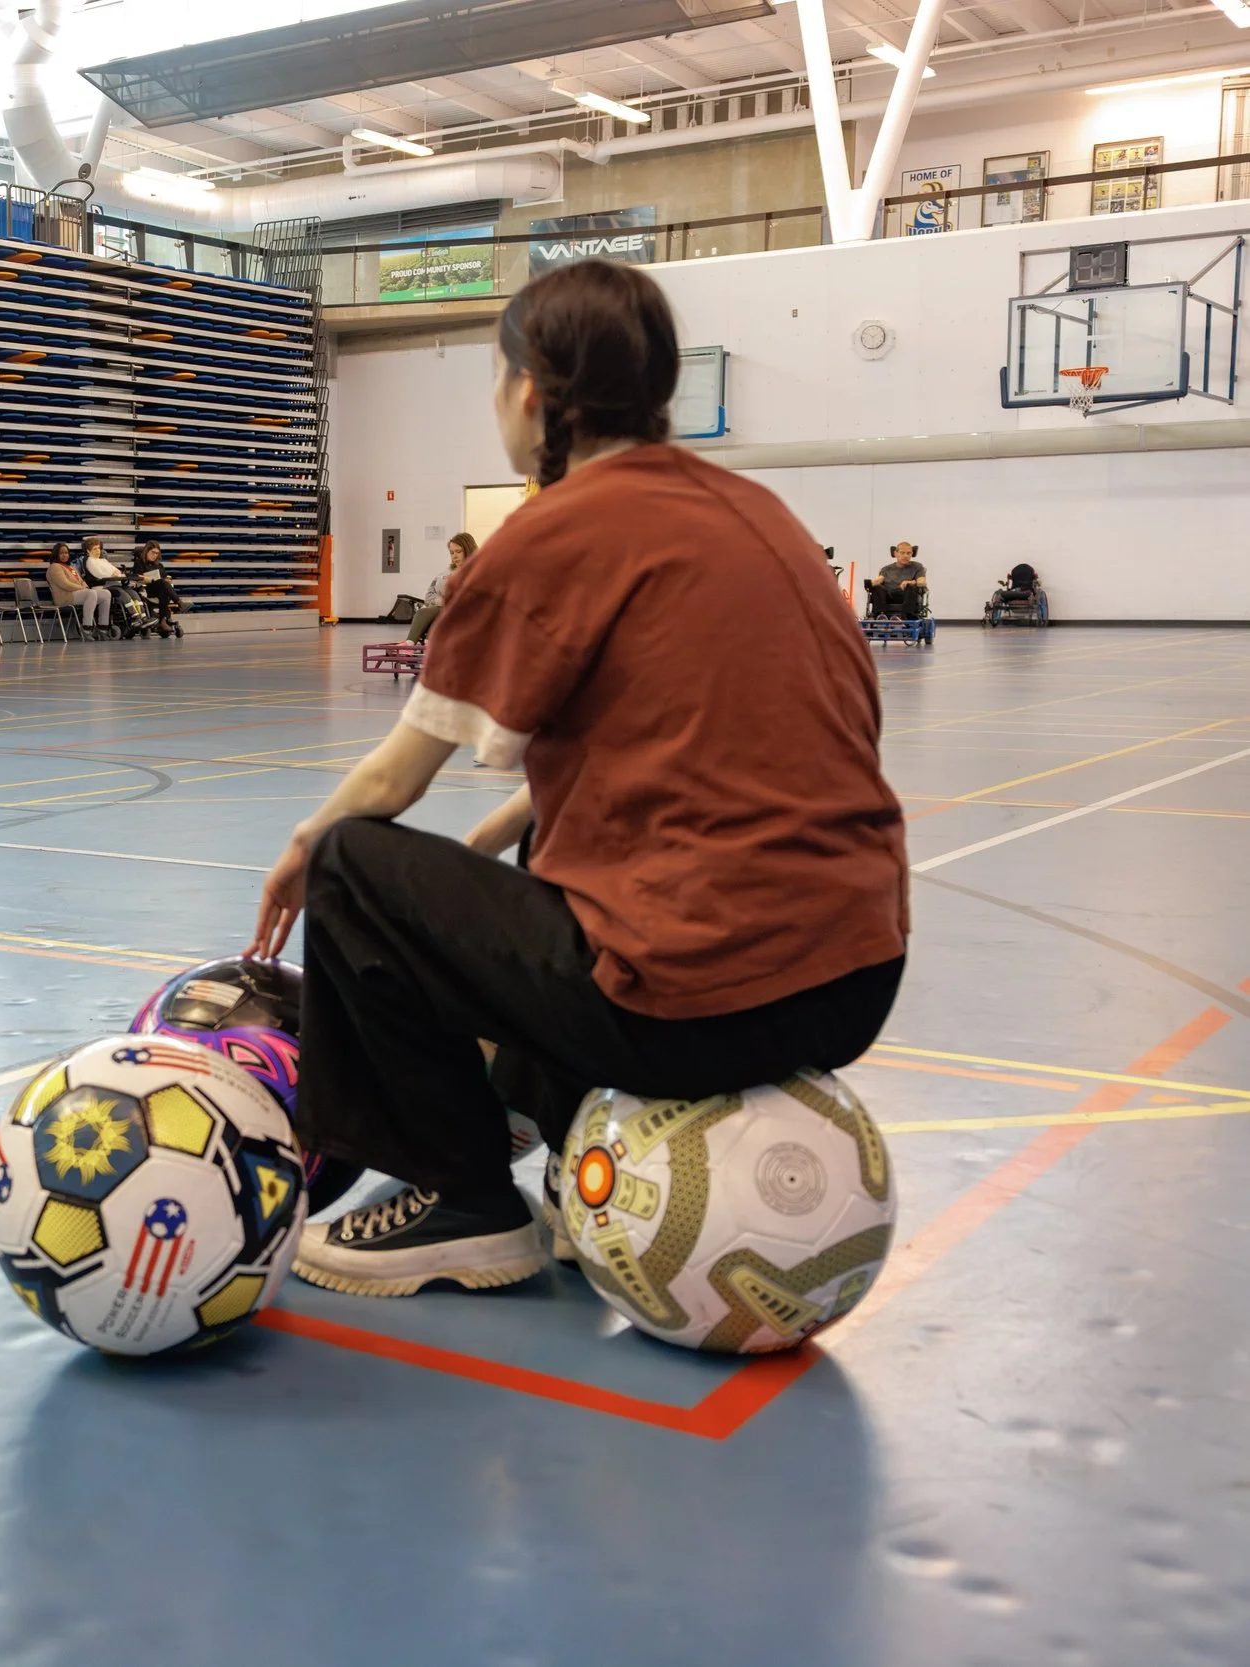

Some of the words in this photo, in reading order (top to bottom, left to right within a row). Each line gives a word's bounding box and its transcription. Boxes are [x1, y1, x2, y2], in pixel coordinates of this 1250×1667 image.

[910, 171, 937, 182] HOME
[940, 169, 952, 178] OF
[538, 234, 643, 260] VANTAGE
[391, 269, 412, 279] PROUD
[413, 264, 451, 275] COMMUNITY
[452, 260, 482, 271] SPONSOR
